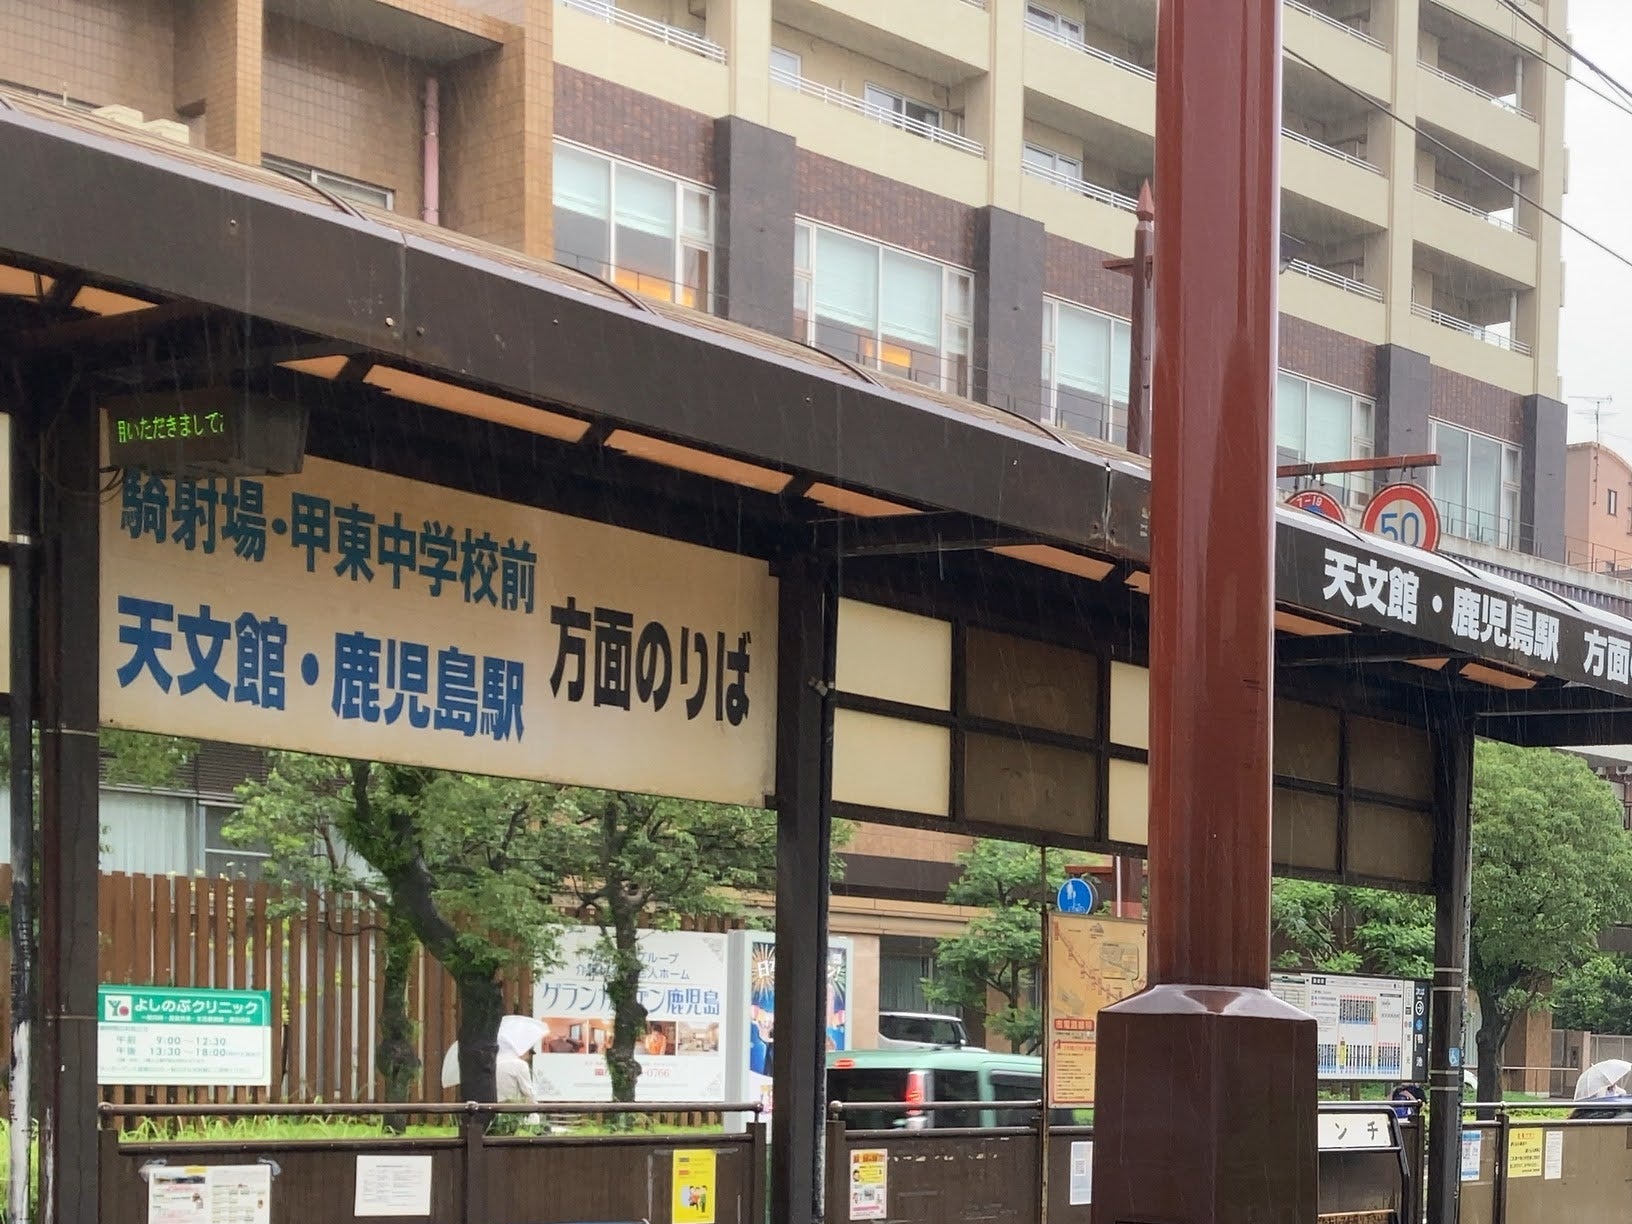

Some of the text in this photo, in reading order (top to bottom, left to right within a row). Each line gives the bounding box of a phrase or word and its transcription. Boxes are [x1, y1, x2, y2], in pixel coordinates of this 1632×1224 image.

[119, 457, 536, 614] 騎射場・甲東中学校前
[1381, 512, 1419, 545] 50
[1322, 548, 1560, 664] 天文館・鹿児島駅
[117, 594, 752, 743] 天文館・鹿児島駅 方面のりば
[134, 998, 259, 1015] よしのぶクリニック
